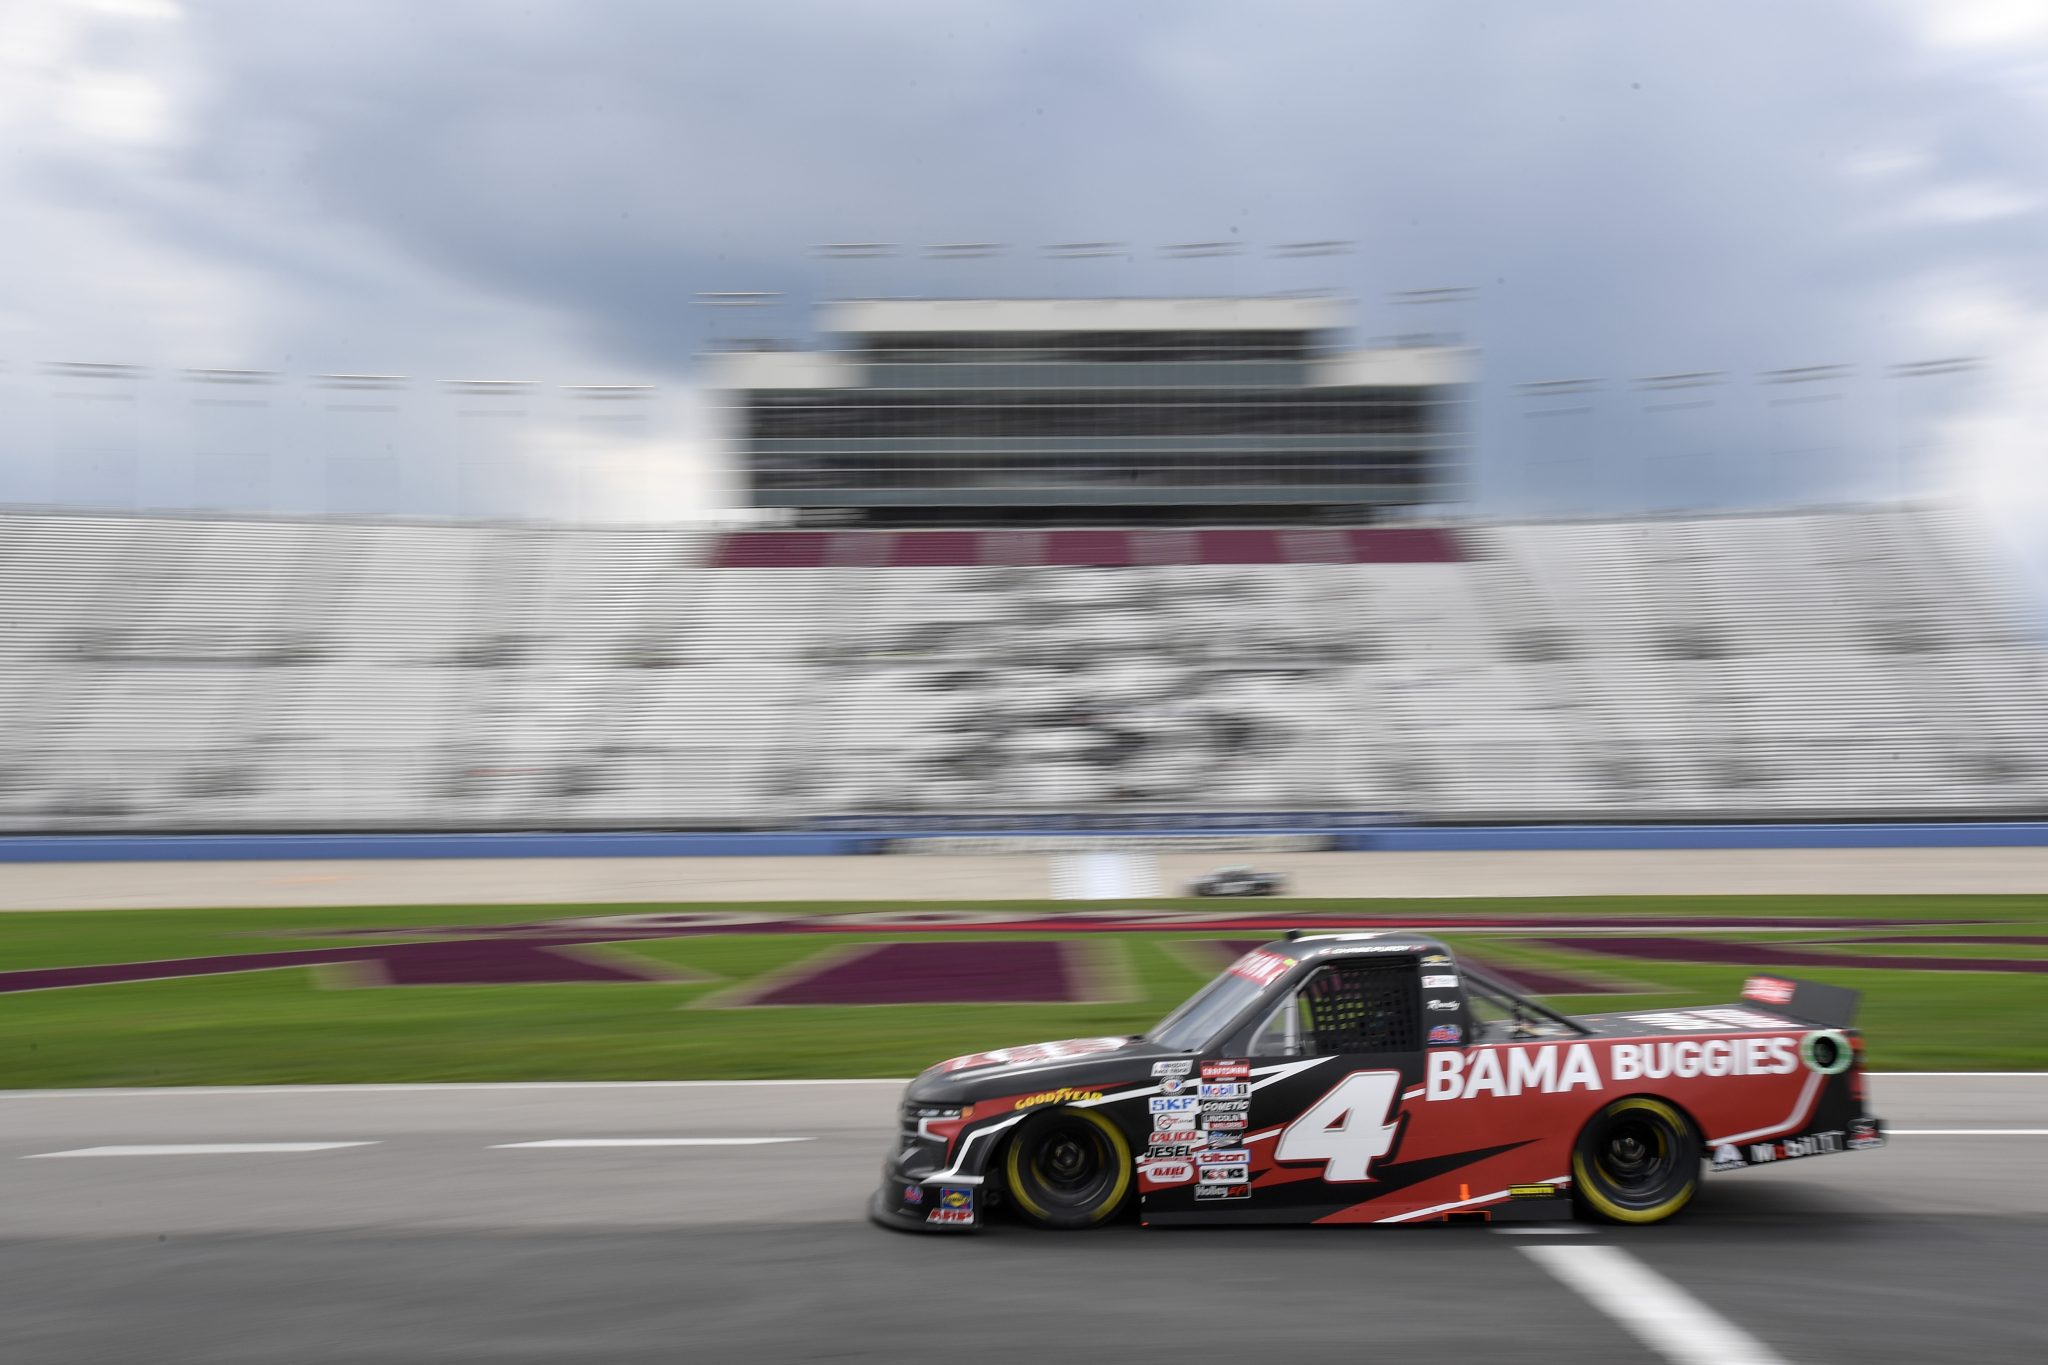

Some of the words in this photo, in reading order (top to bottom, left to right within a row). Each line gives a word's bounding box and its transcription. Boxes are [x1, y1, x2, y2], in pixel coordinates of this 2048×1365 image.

[1611, 1037, 1798, 1080] BUGGIES
[1201, 1085, 1234, 1096] Mobil
[1237, 1083, 1248, 1095] 1
[1014, 1087, 1104, 1110] GOODYEAR
[1152, 1098, 1195, 1111] SKF
[1203, 1101, 1249, 1112] COMETIC
[1273, 1069, 1400, 1182] 4
[1151, 1131, 1196, 1142] CALICO
[1144, 1145, 1193, 1158] JESEL
[1196, 1184, 1228, 1198] Holley
[928, 1209, 973, 1221] ARP
